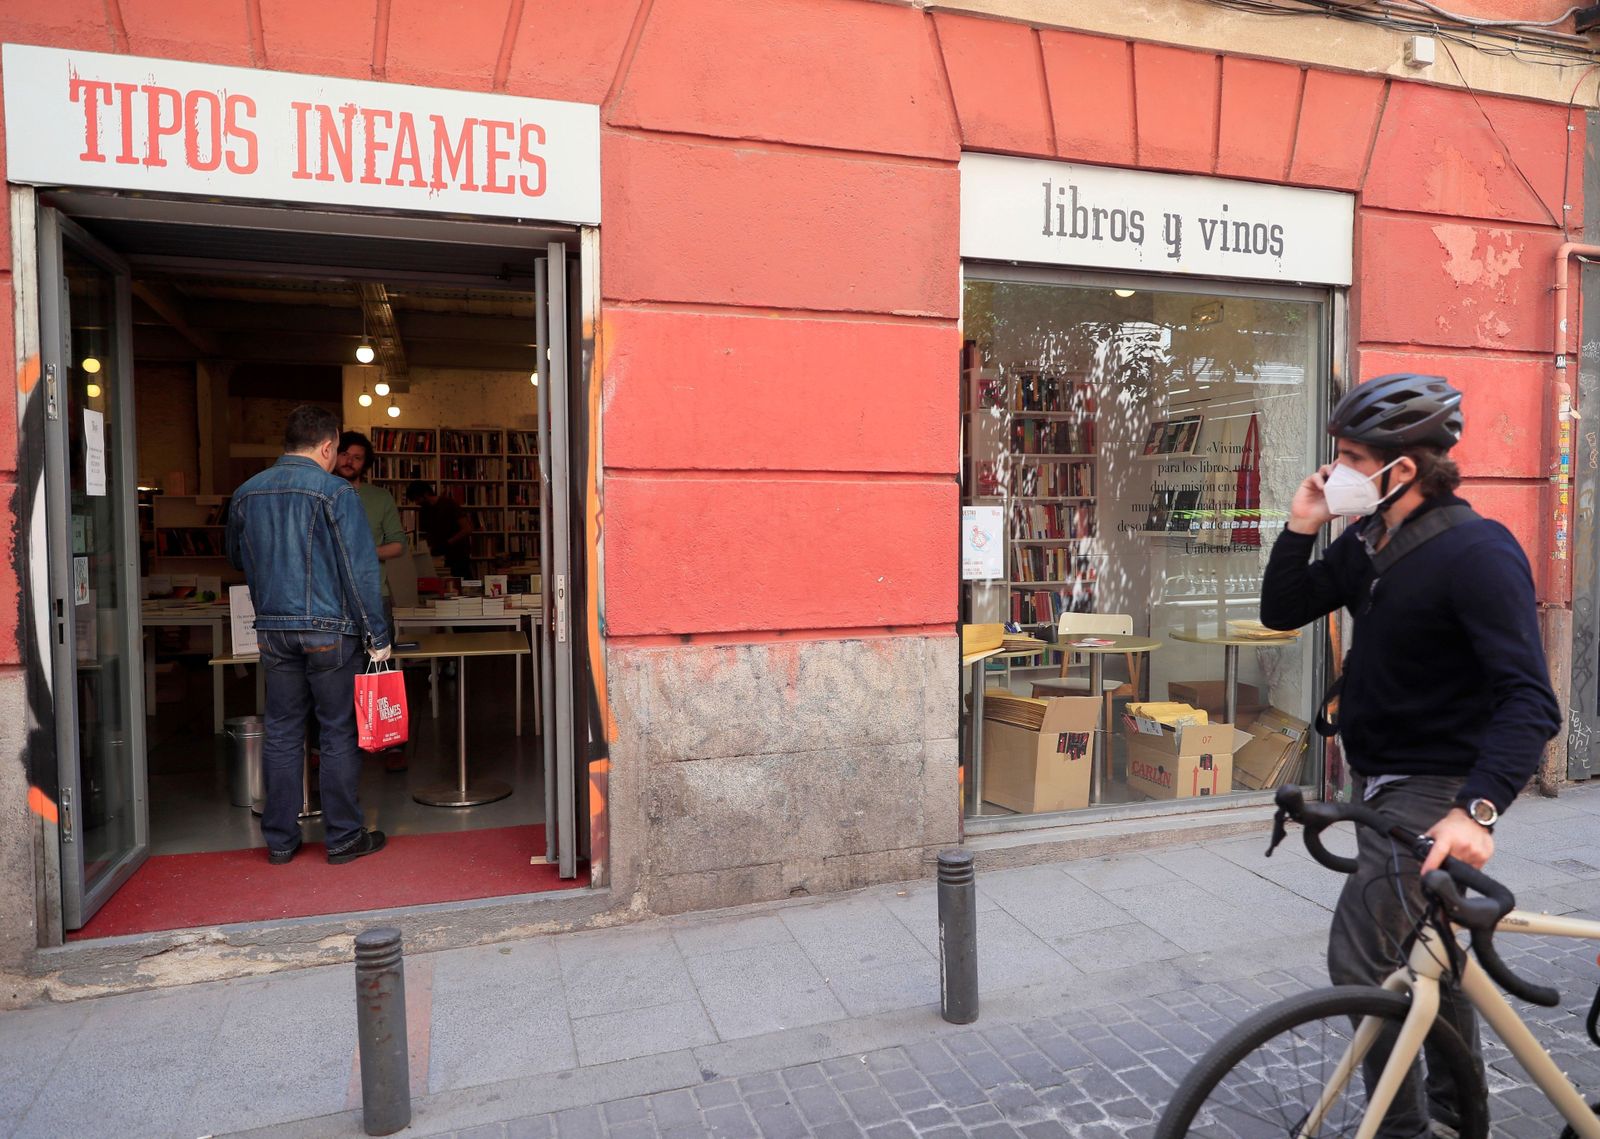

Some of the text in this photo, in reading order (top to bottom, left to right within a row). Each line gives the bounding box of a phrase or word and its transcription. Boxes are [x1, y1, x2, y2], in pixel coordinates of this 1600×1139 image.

[69, 67, 548, 198] TIPOS INFAMES
[1041, 178, 1285, 262] libros y vinos
[1157, 464, 1180, 477] para
[1183, 460, 1198, 473] los
[1150, 480, 1179, 493] dulce
[1180, 480, 1215, 493] misión
[1217, 484, 1230, 492] en
[1185, 542, 1253, 555] Umberto Eco
[1202, 736, 1212, 745] 07
